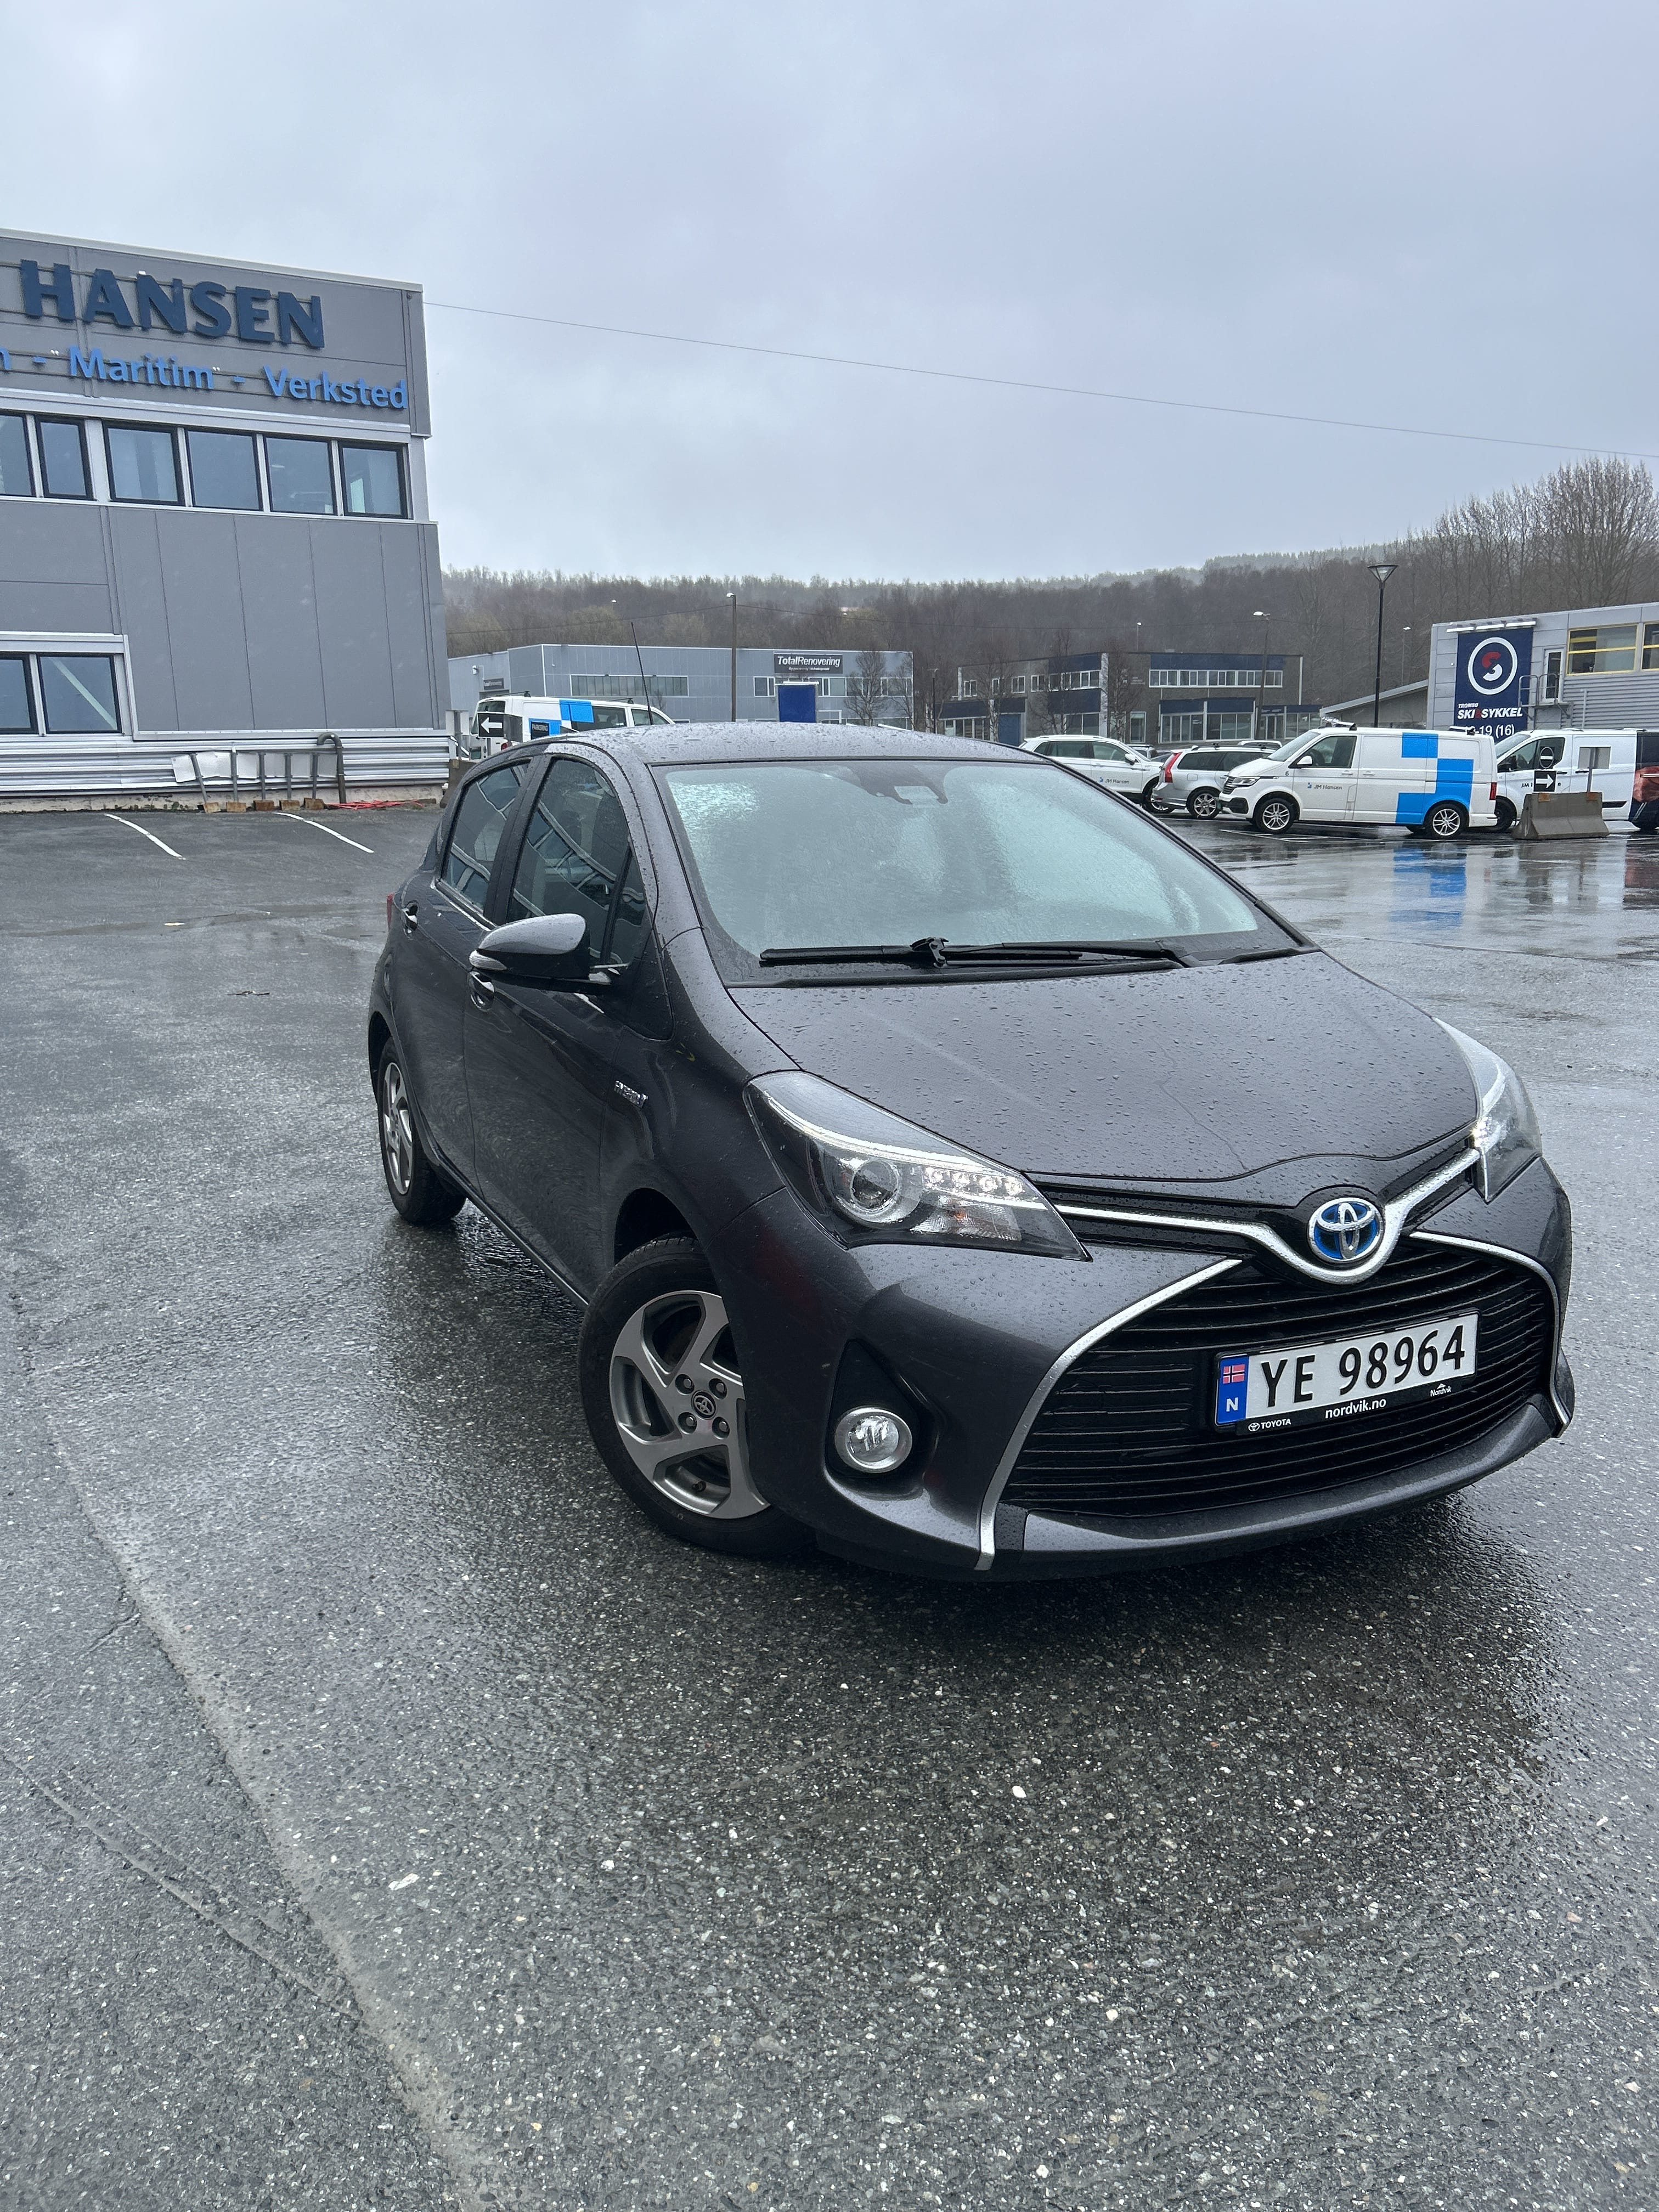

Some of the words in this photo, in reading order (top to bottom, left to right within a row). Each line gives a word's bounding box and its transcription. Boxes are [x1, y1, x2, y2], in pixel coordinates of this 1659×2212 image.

[20, 259, 325, 348] HANSEN
[69, 345, 214, 390] Maritim
[264, 365, 408, 409] Verksted
[777, 656, 840, 668] TotalRenovering
[1261, 1355, 1315, 1408] YE
[1339, 1325, 1465, 1396] 98964
[1430, 1385, 1452, 1397] Nordvik
[1226, 1397, 1239, 1412] N
[1325, 1398, 1387, 1419] nordvik.no
[1261, 1418, 1291, 1429] TOYOTA
